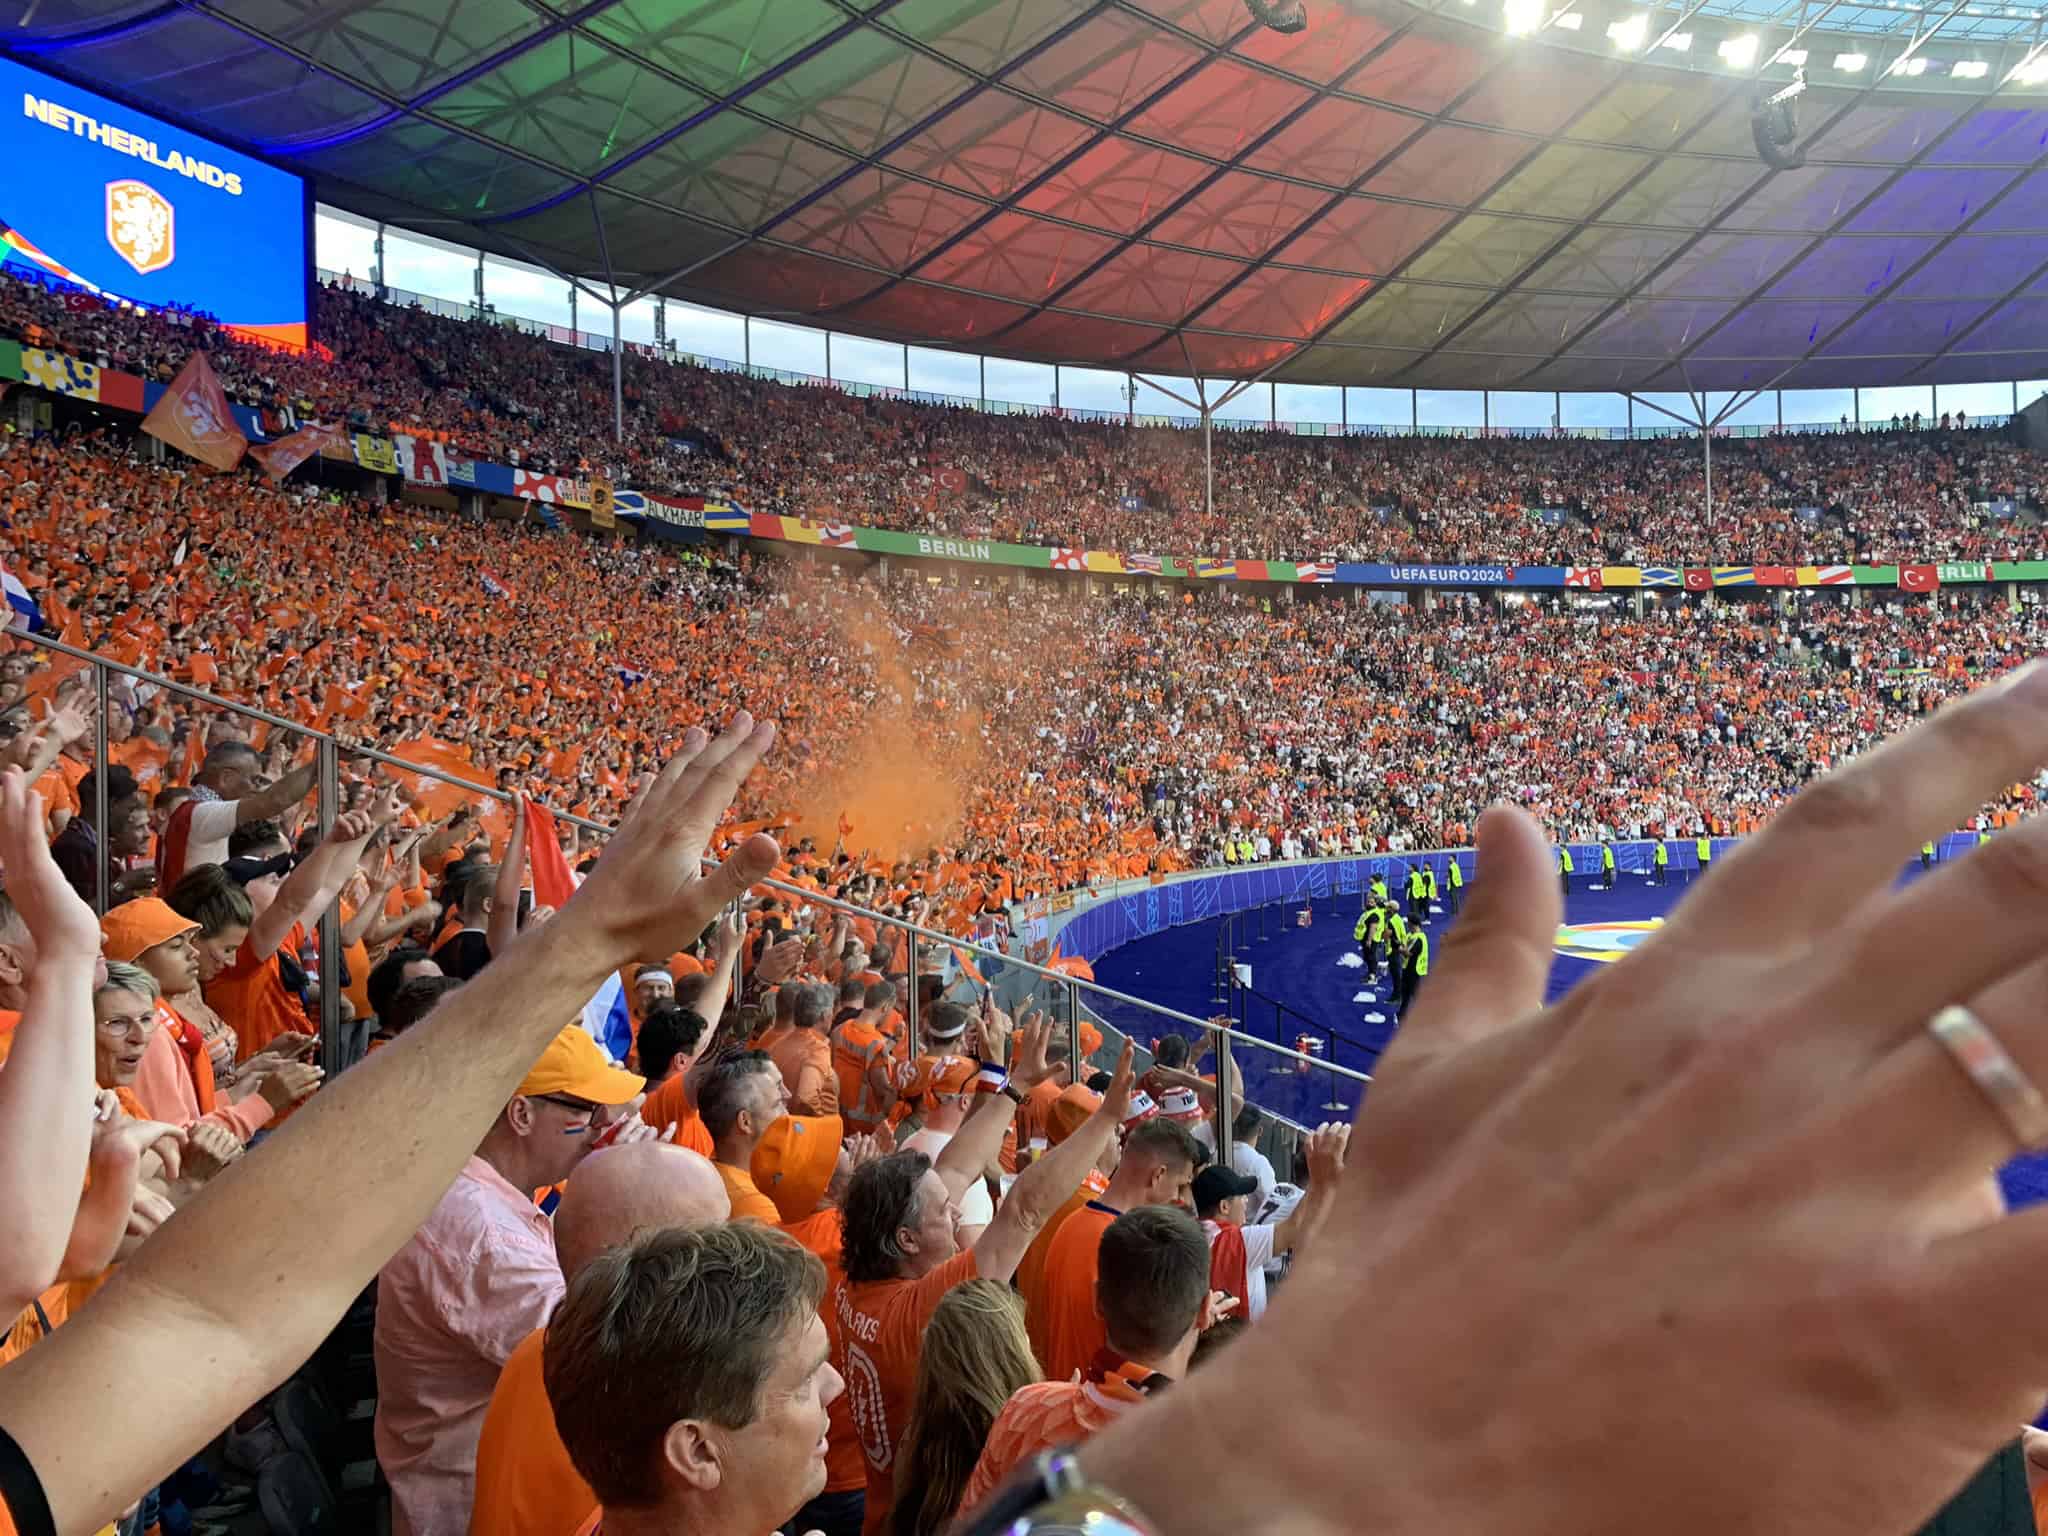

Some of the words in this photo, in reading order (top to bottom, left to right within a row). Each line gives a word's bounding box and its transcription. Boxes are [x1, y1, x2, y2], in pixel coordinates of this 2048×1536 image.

[24, 93, 243, 195] NETHERLANDS
[649, 500, 704, 527] ALKMAAR
[919, 538, 990, 560] BERLIN
